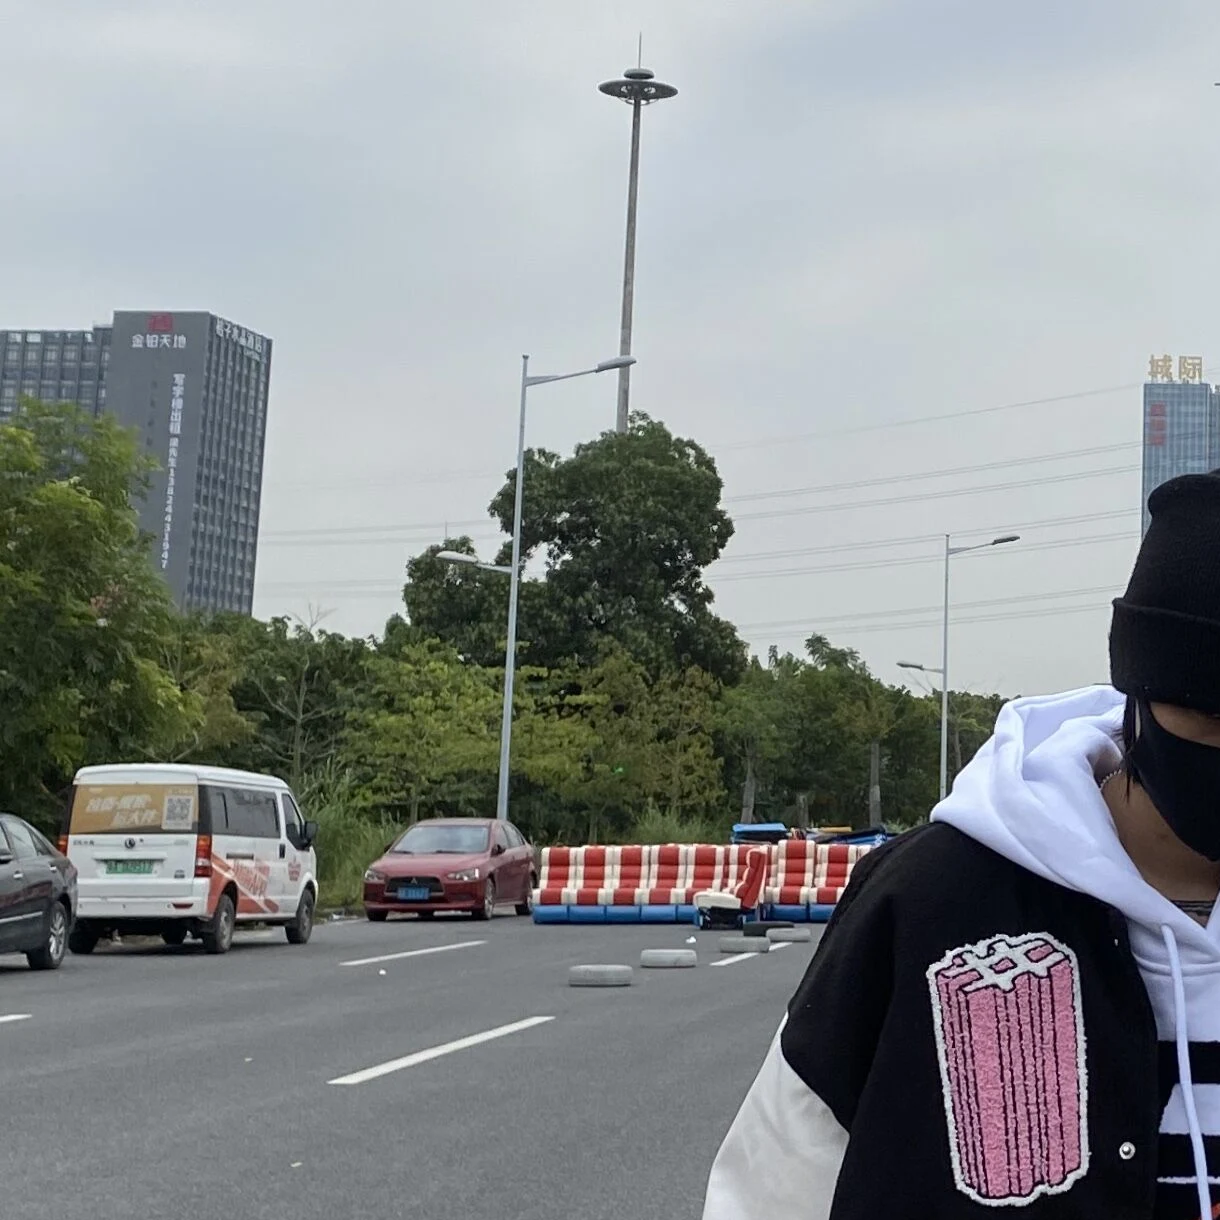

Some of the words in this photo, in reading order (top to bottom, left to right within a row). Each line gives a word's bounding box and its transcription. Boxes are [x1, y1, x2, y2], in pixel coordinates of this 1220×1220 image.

[132, 334, 187, 348] 金铂天地
[1148, 354, 1203, 380] 城际
